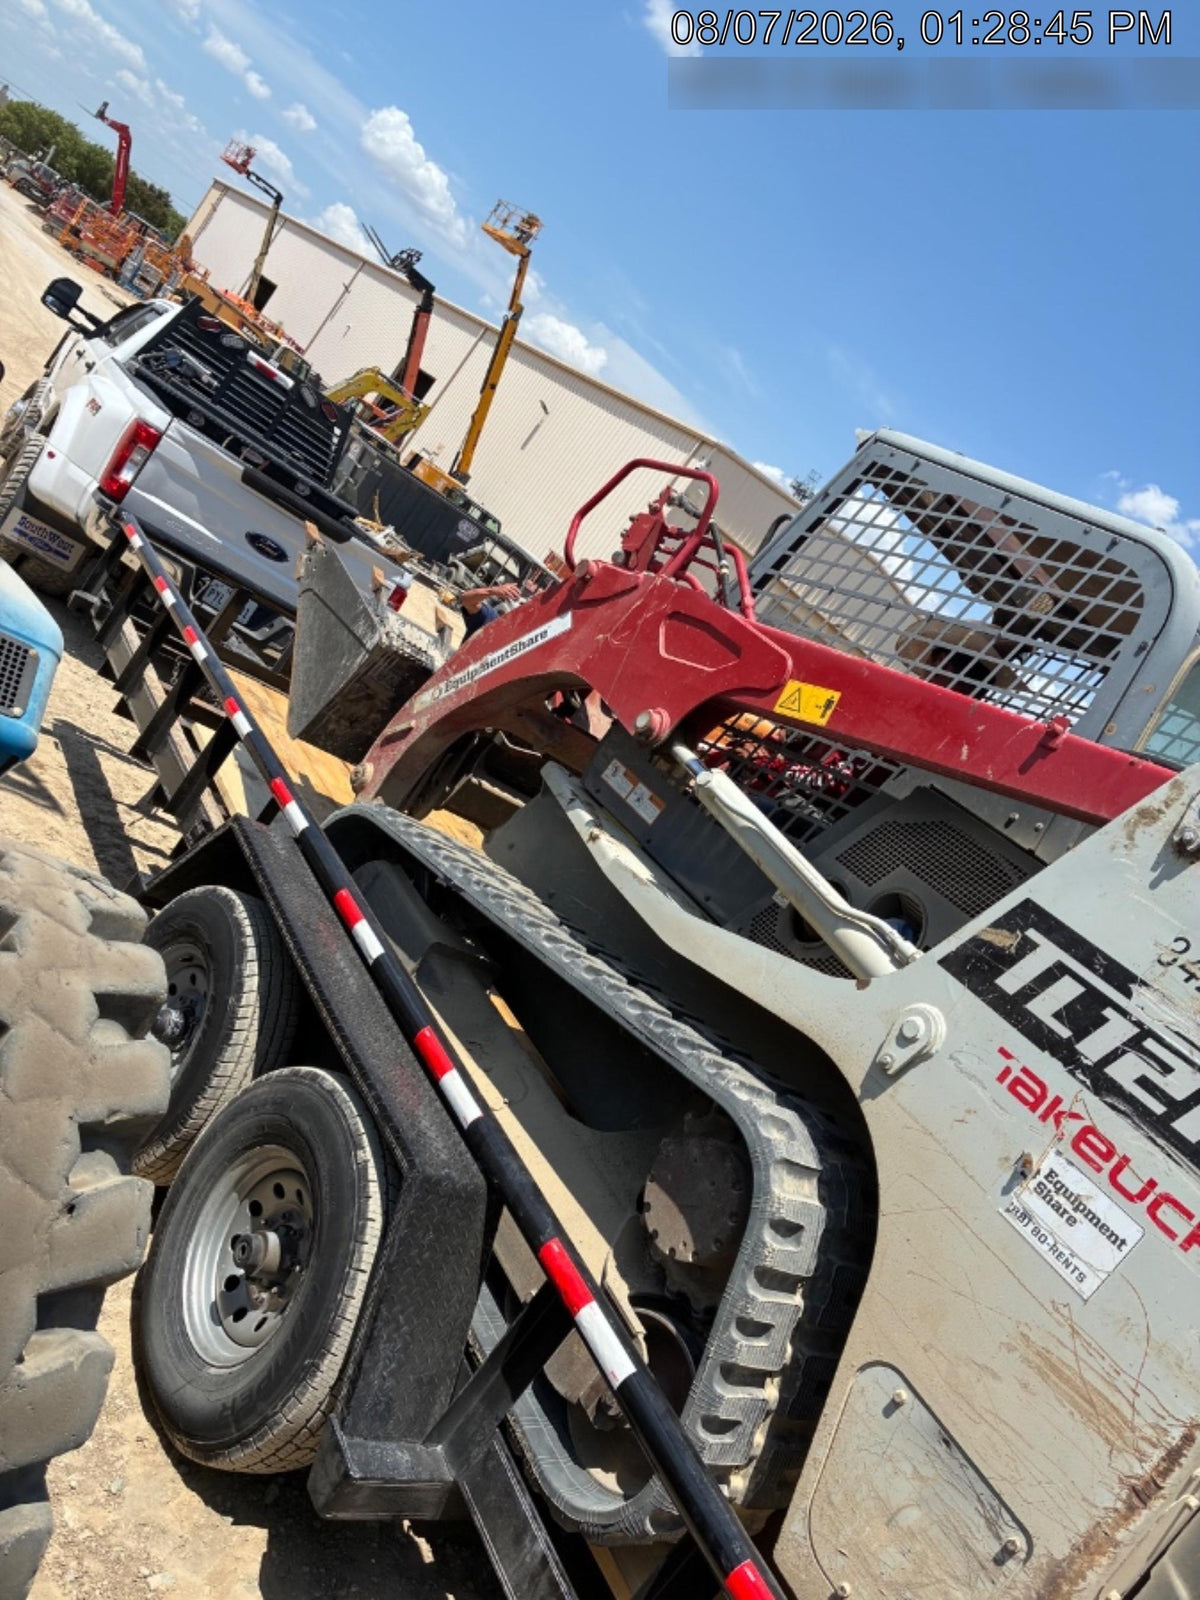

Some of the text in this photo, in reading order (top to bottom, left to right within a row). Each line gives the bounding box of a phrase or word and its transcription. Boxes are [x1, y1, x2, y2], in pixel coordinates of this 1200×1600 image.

[444, 628, 549, 692] EquipmentShare
[1033, 1180, 1078, 1228] Share
[1043, 1167, 1128, 1252] Equipment
[1030, 1225, 1088, 1284] 80-RENTS
